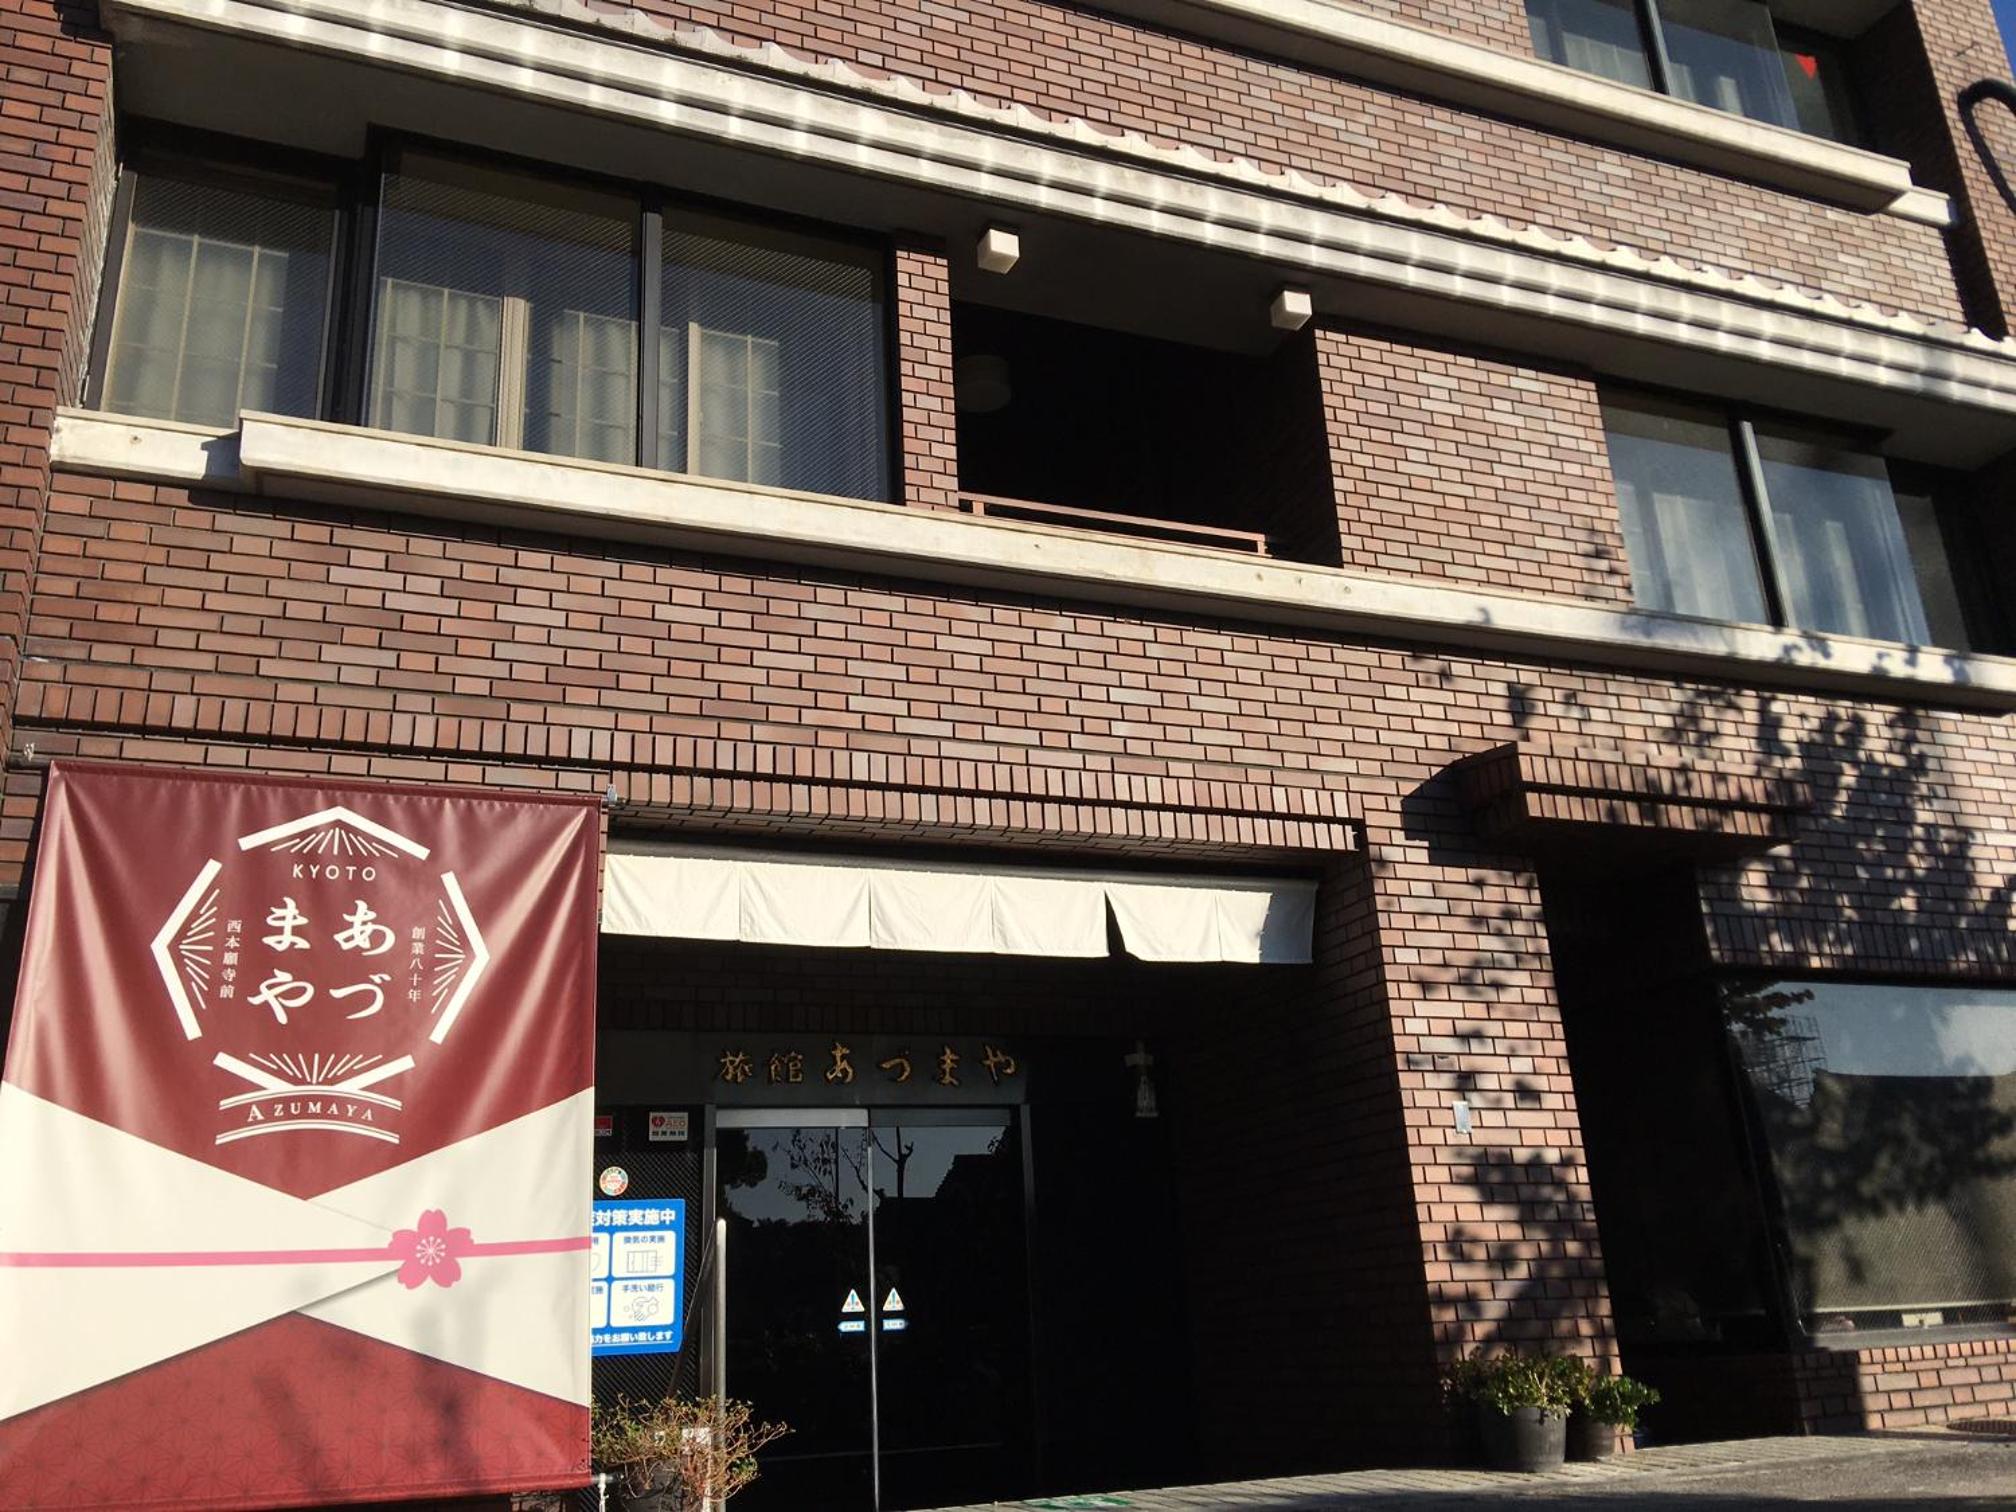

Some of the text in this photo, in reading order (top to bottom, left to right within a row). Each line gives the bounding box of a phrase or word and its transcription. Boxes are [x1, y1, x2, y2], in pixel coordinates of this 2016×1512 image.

[292, 863, 376, 881] KYOTO
[219, 919, 242, 999] 西本願寺前
[407, 926, 425, 1003] 創業八十年
[247, 1101, 374, 1121] AZUMAYA
